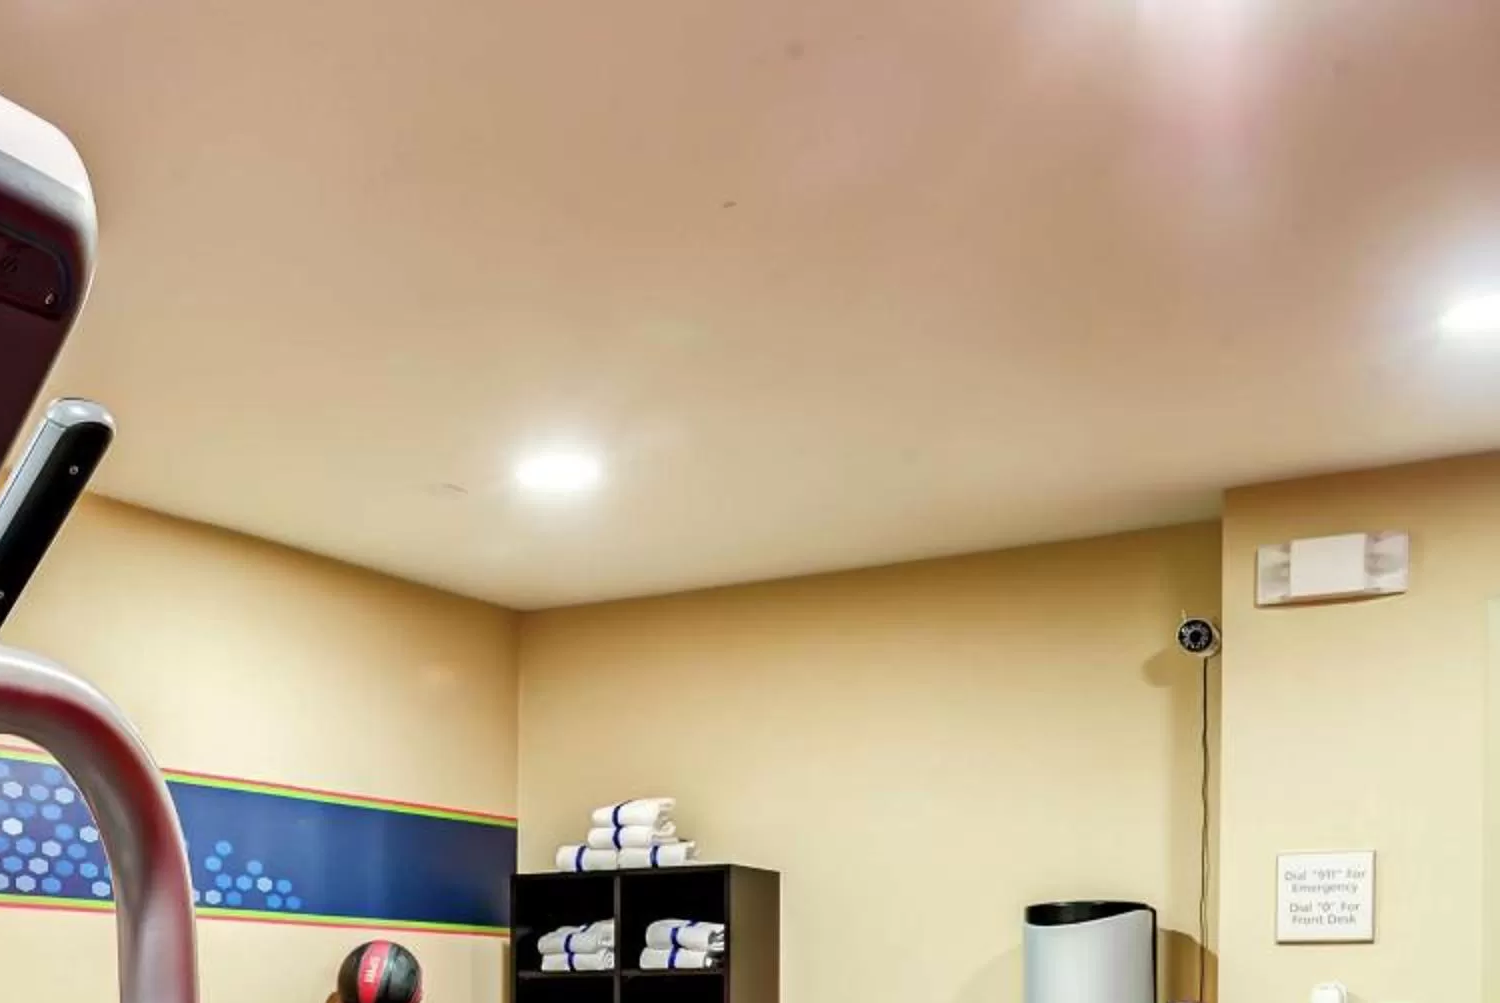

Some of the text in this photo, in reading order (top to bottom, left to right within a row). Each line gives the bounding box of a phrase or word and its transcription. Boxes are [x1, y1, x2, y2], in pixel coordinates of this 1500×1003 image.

[1284, 869, 1307, 881] Dial
[1345, 866, 1365, 879] For
[1291, 883, 1359, 895] Emergency
[1289, 900, 1313, 913] Dial
[1340, 901, 1360, 912] For
[1291, 913, 1357, 925] Front Desk
